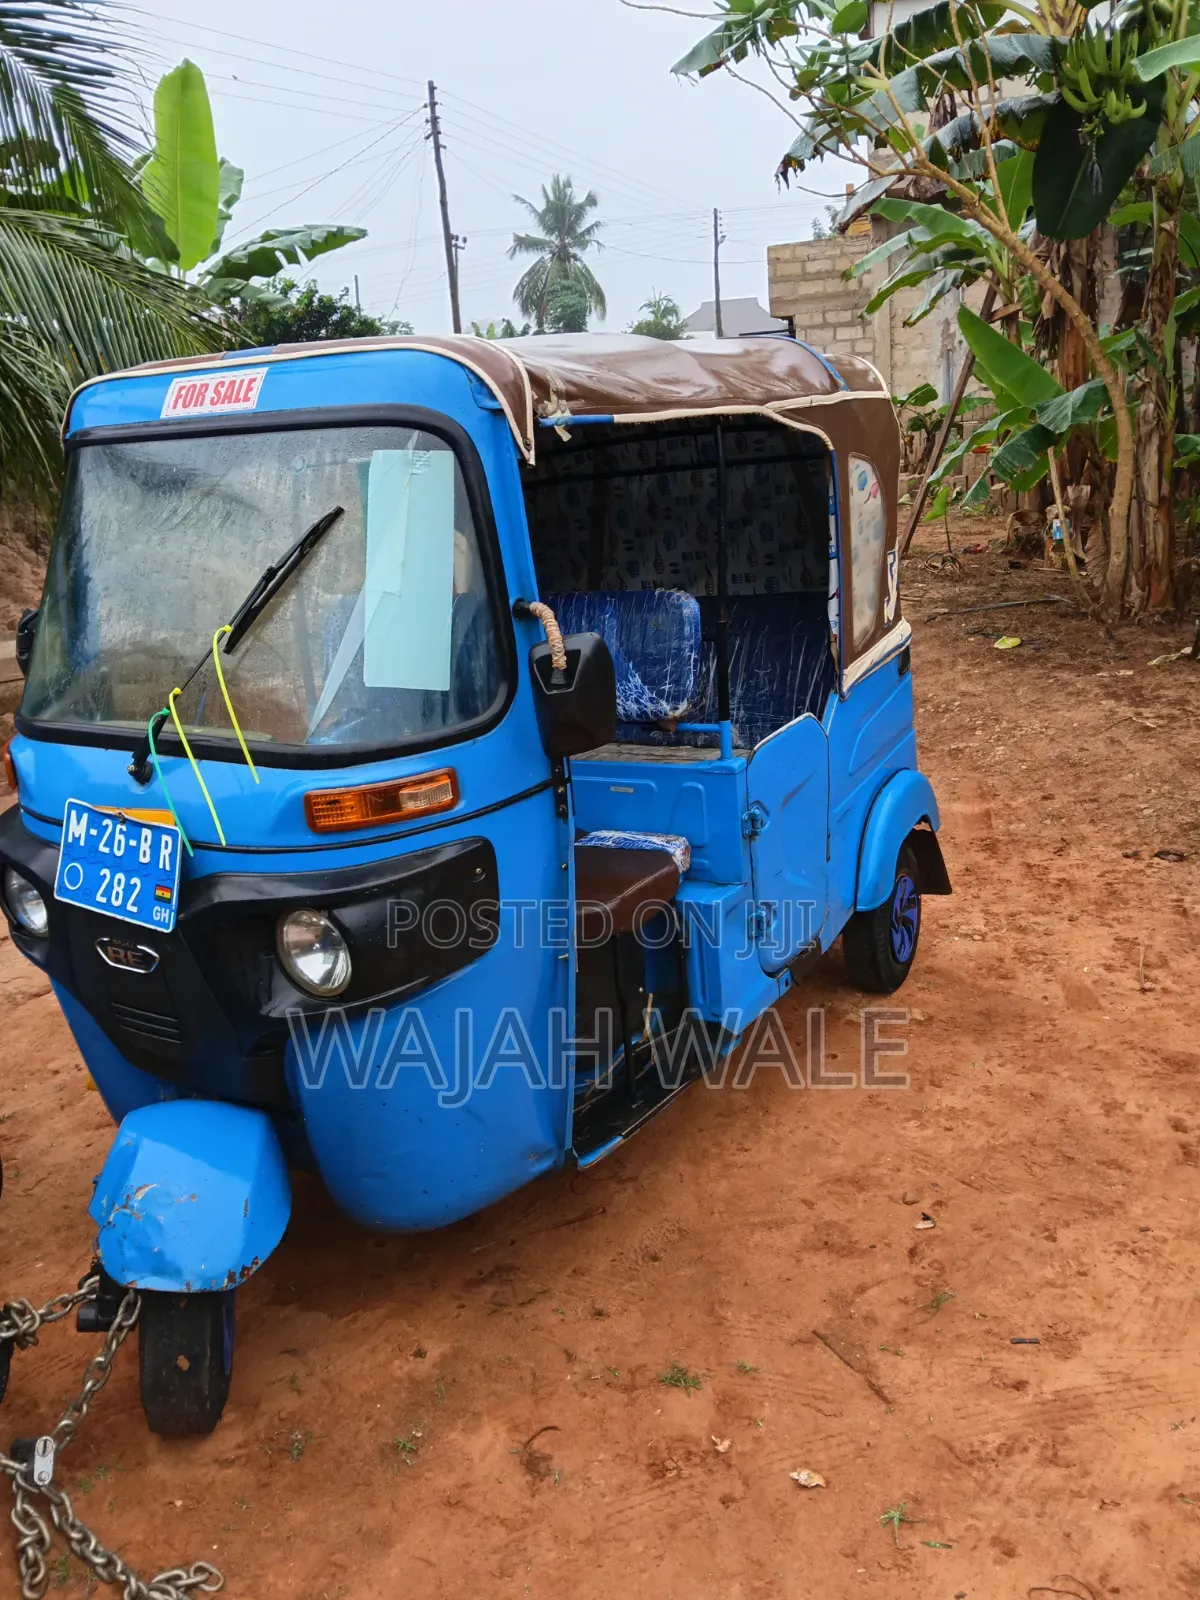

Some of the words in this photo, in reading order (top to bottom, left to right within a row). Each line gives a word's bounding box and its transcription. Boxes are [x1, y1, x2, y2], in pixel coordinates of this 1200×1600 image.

[172, 382, 210, 410] FOR
[210, 377, 257, 406] SALE
[95, 868, 142, 913] 282
[152, 905, 170, 924] GH
